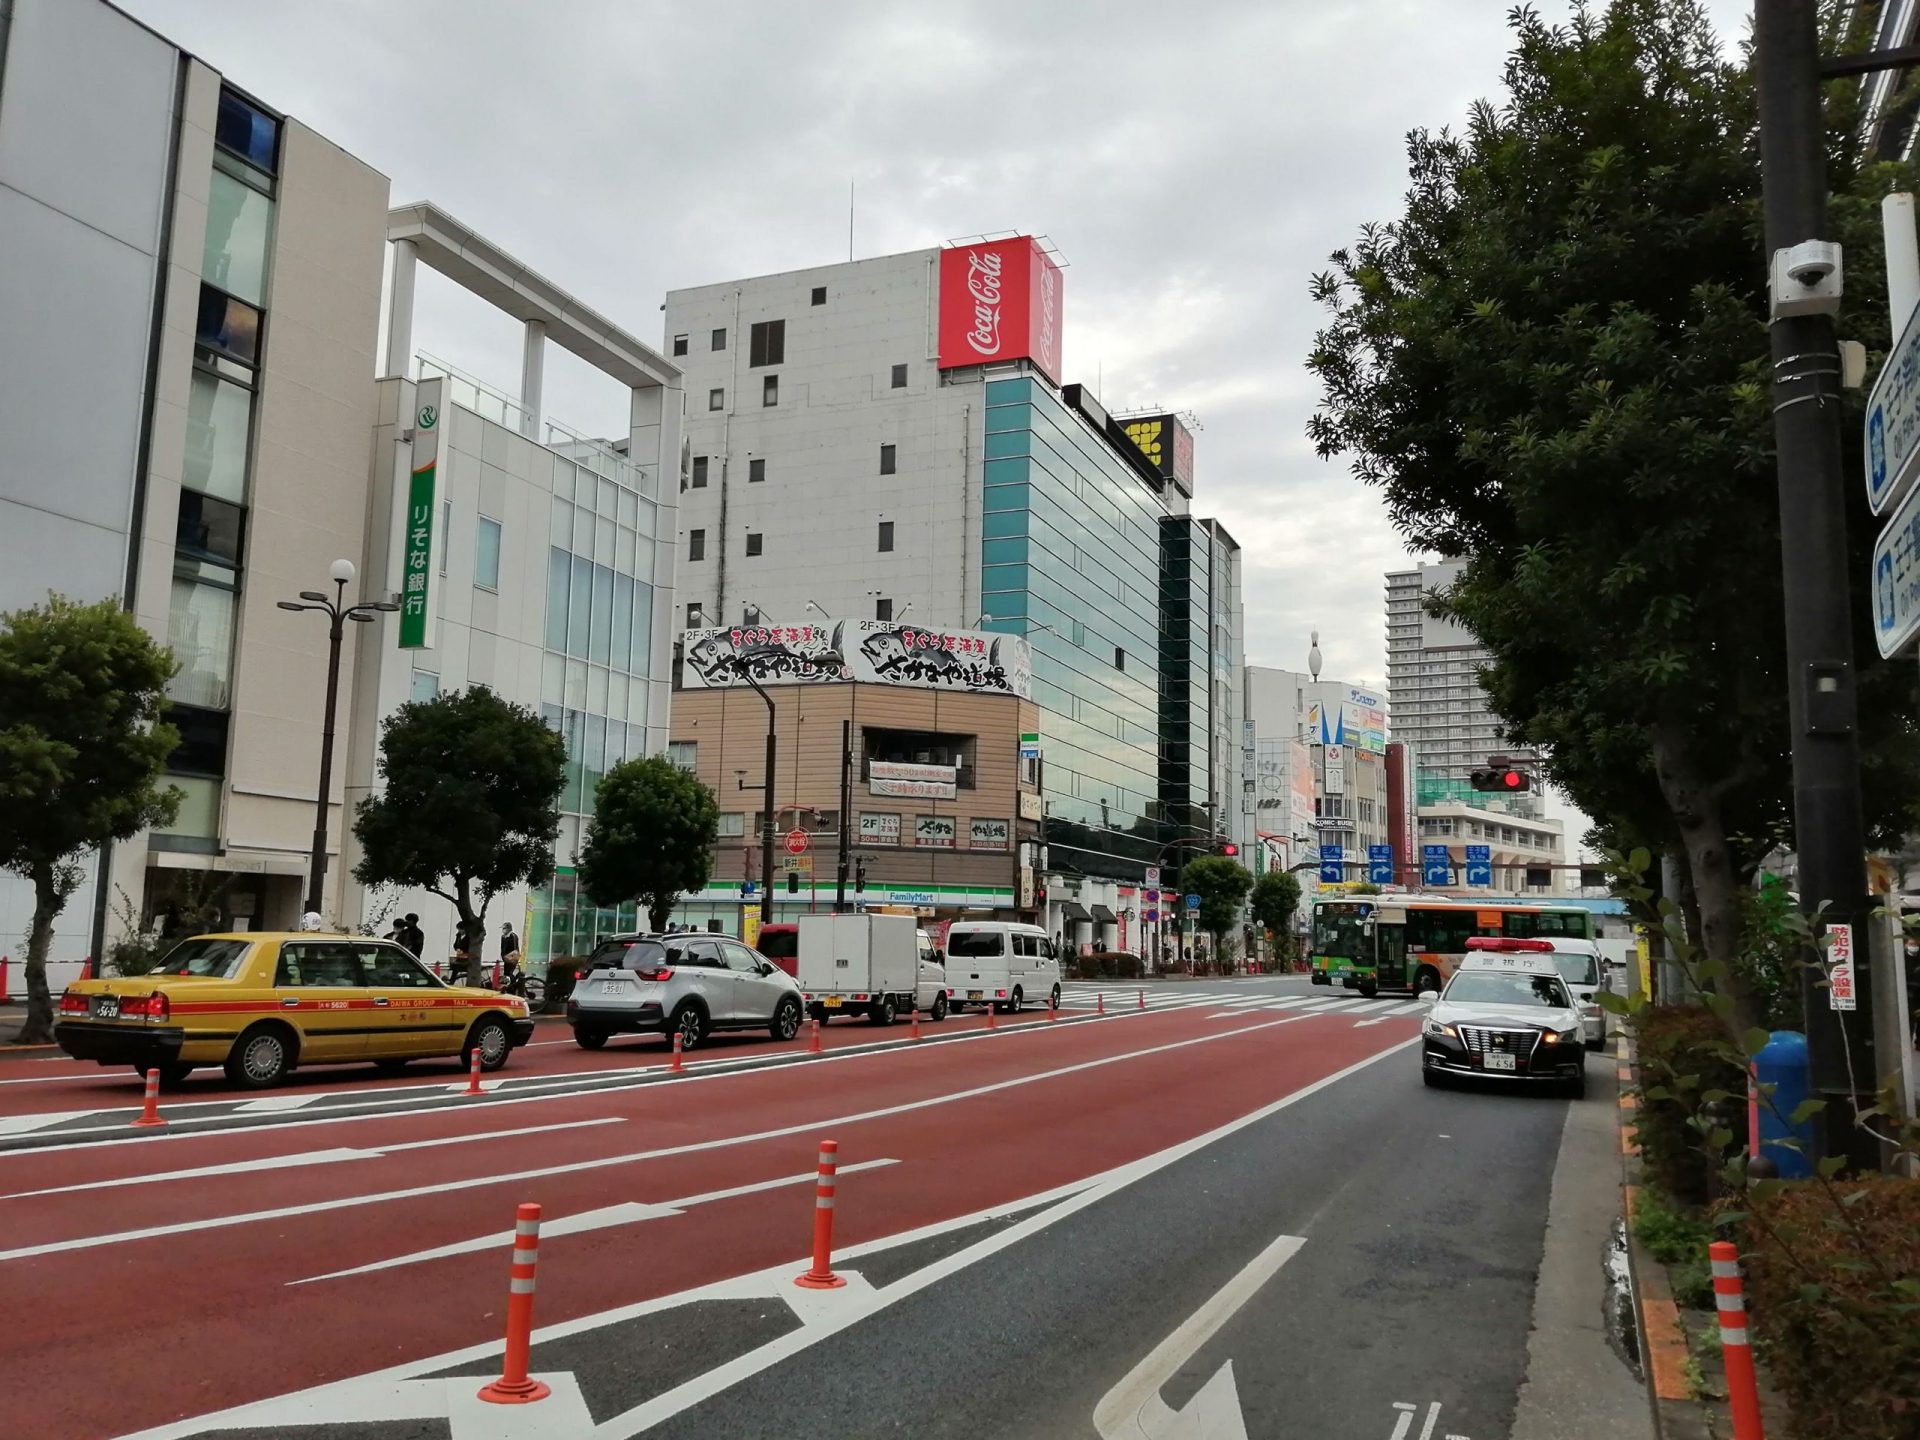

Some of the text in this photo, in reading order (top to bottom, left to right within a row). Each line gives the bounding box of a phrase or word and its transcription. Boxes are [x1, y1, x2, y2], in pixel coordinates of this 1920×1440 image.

[967, 249, 1001, 355] Coca-Cola
[406, 504, 429, 615] りそな銀行
[731, 626, 814, 647] まぐろ居酒屋
[903, 630, 986, 654] まぐろ居酒屋
[875, 654, 1008, 690] さかなや道場
[862, 818, 878, 829] 2F
[918, 820, 953, 835] さかな
[972, 824, 1006, 837] や道場
[1468, 846, 1488, 855] 王子駅
[889, 892, 934, 903] FamilyMart
[1831, 926, 1852, 998] 防犯カラ設置
[331, 1001, 347, 1009] 5620
[413, 1000, 435, 1008] GROUP
[99, 1006, 118, 1017] 56-20
